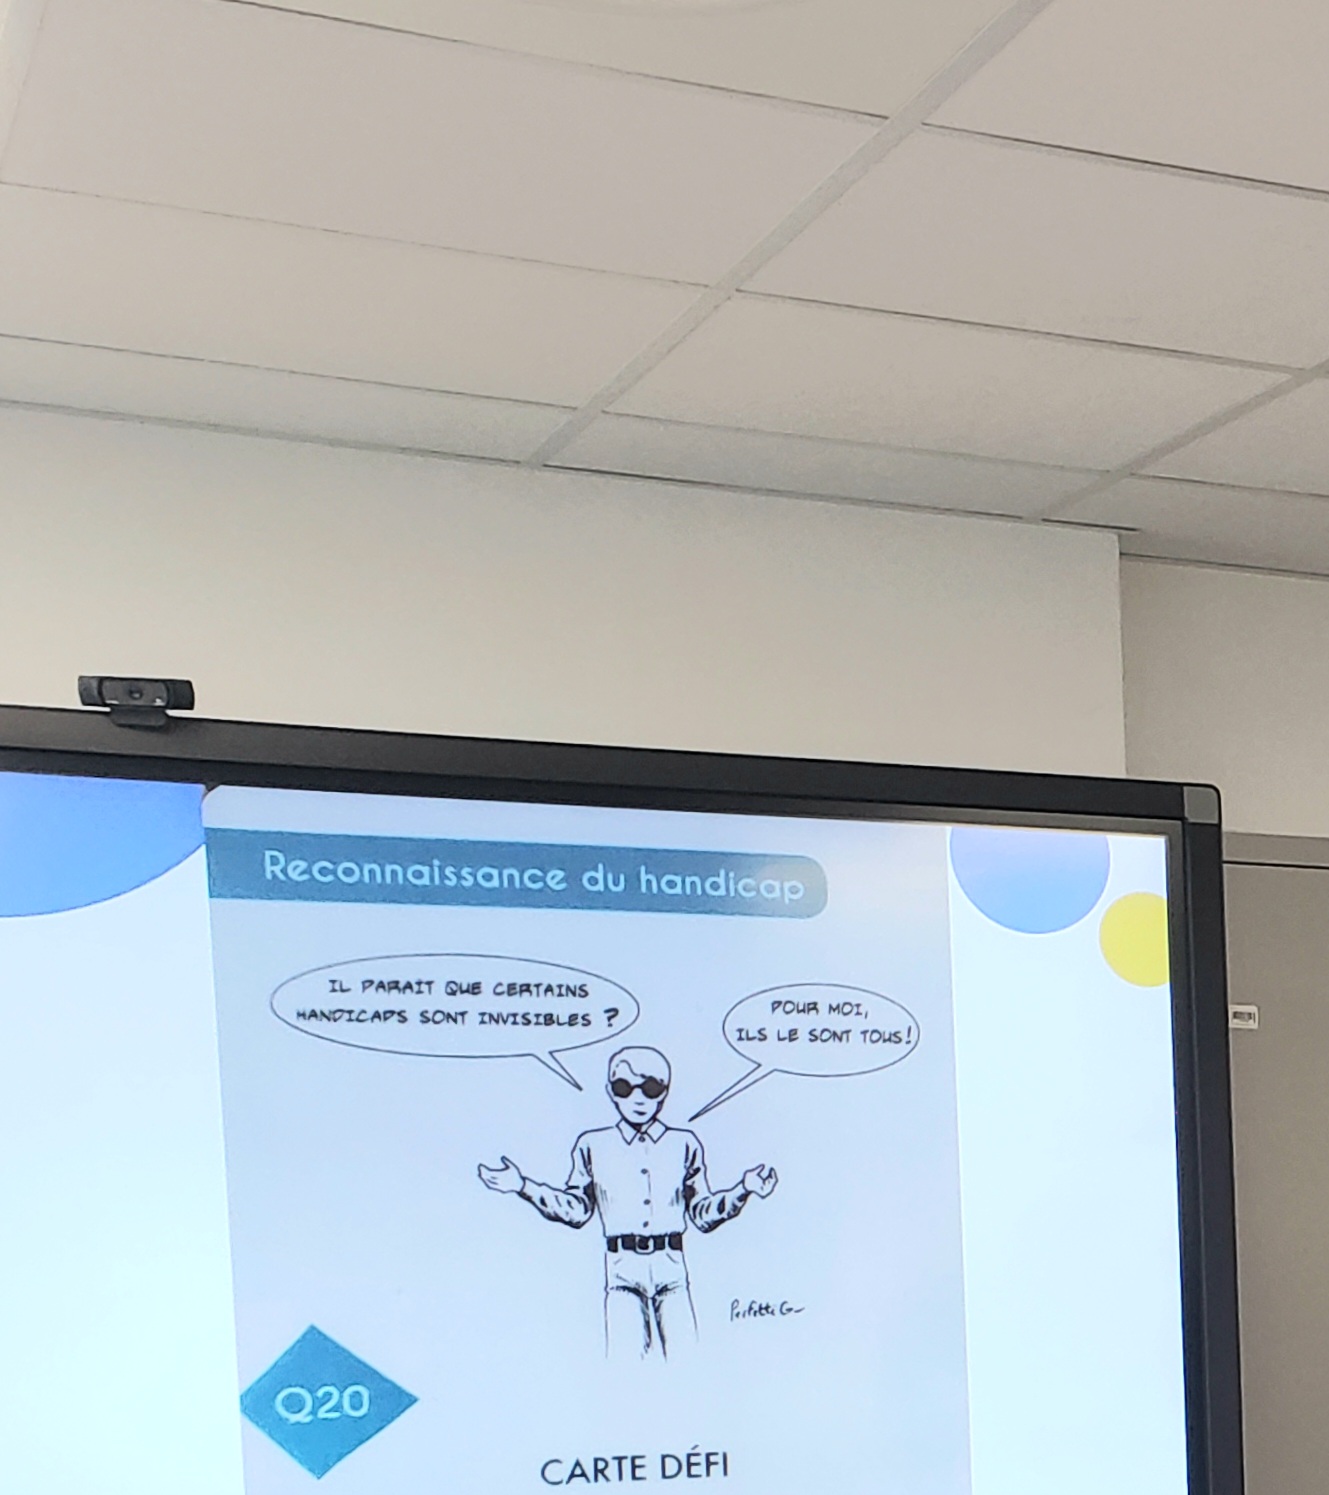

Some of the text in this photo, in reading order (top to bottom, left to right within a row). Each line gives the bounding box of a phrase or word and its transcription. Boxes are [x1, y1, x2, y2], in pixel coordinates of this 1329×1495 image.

[263, 849, 805, 904] Reconnaissance du handicap
[328, 978, 351, 994] IL
[444, 980, 483, 997] QUE
[492, 982, 590, 998] CERTAINS
[296, 1007, 620, 1028] HANDICAPS SONT INVISIBLES ?
[771, 999, 869, 1020] POUR MOI,
[735, 1027, 768, 1043] ILS
[776, 1028, 800, 1043] LE
[807, 1029, 852, 1044] SONT
[275, 1384, 370, 1424] Q20
[540, 1444, 731, 1486] CARTE DÉFI
